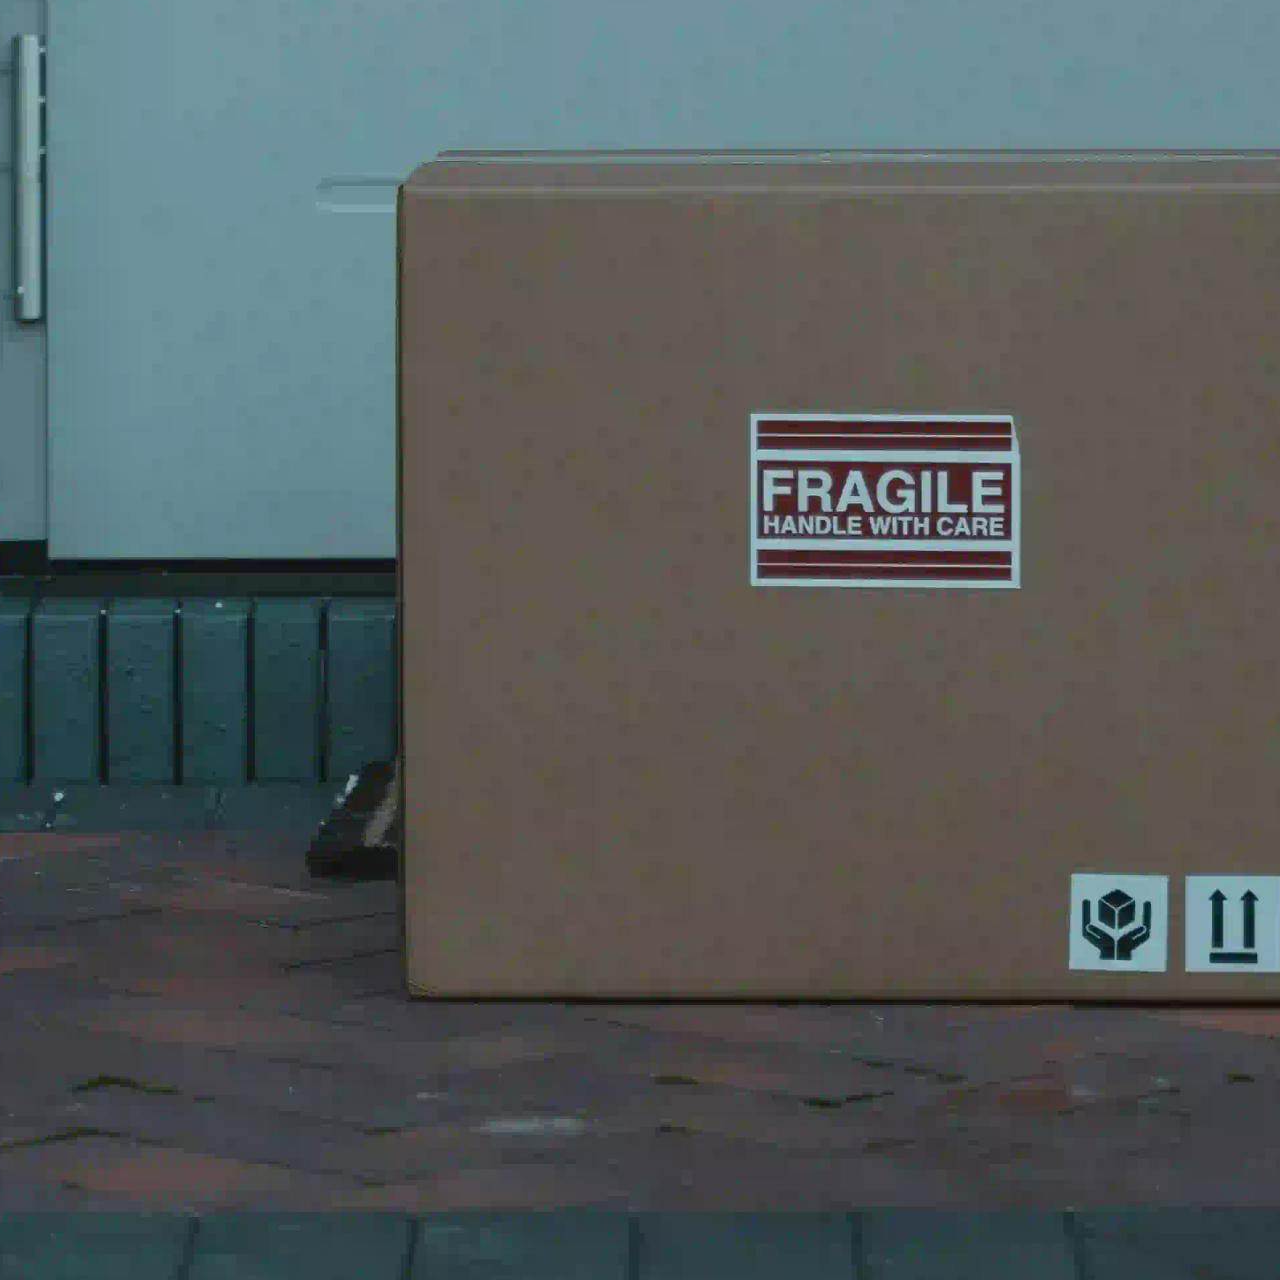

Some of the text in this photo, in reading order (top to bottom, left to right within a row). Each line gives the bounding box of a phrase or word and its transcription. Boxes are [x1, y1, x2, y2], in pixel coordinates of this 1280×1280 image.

[762, 469, 1005, 514] FRAGILE
[762, 514, 1005, 537] HANDLE WITH CARE
